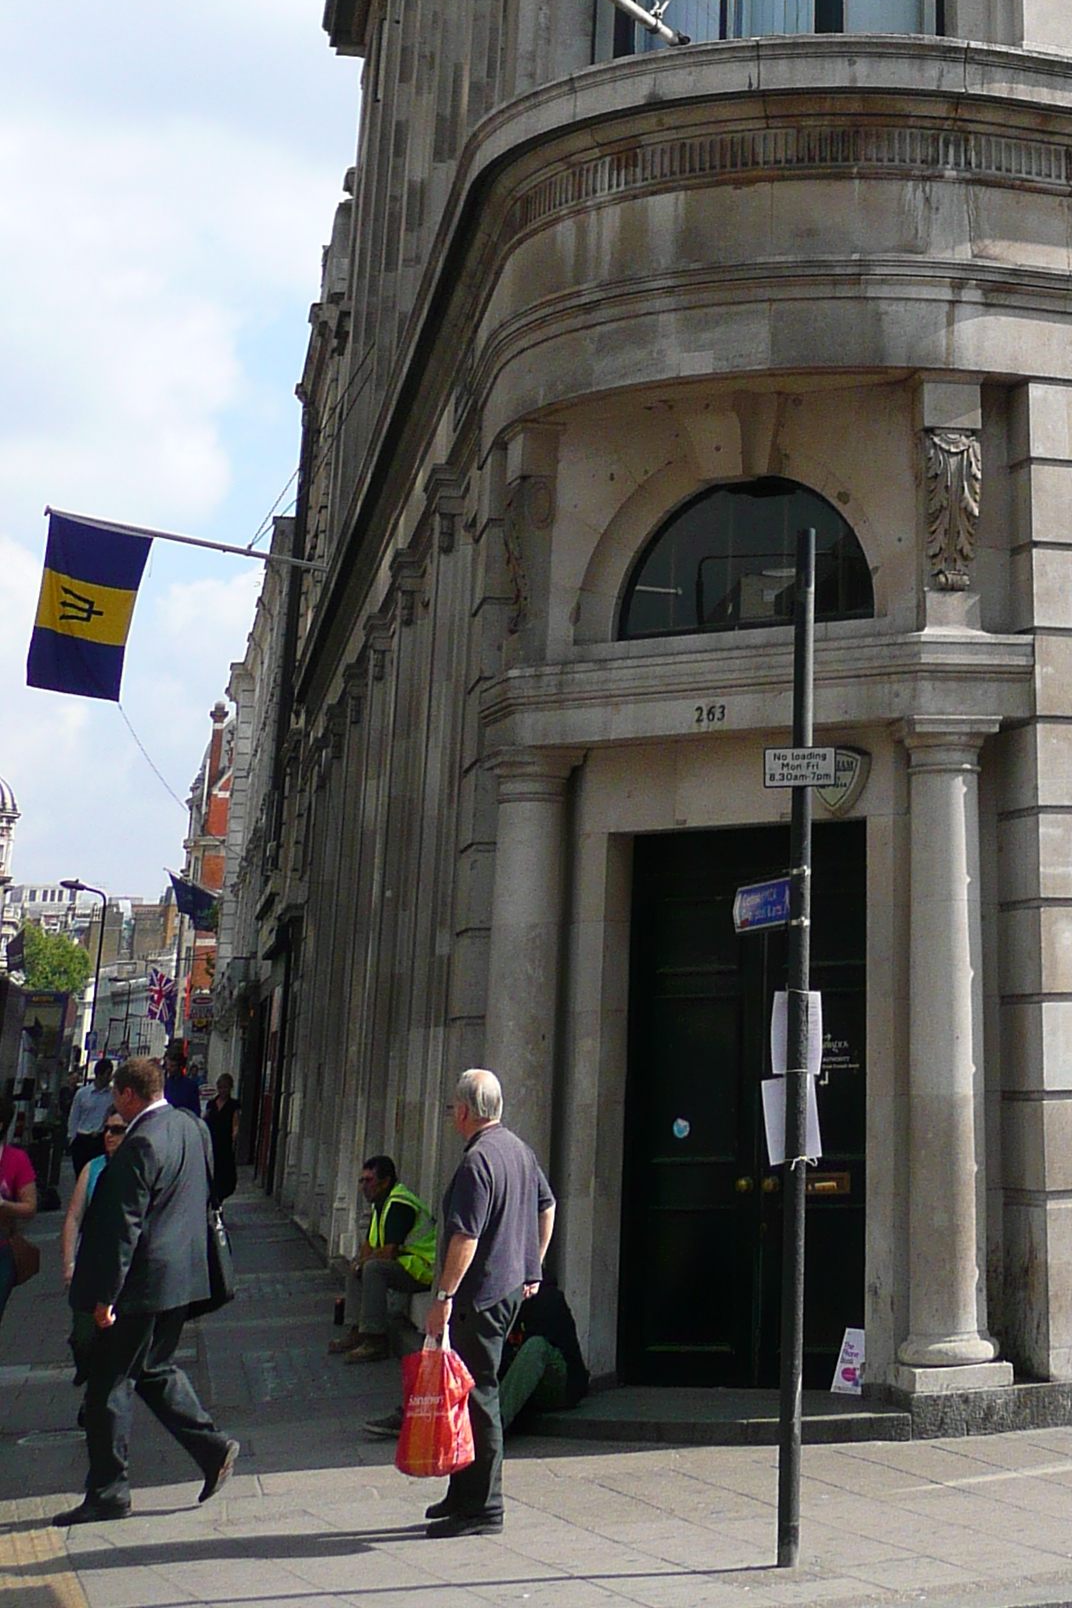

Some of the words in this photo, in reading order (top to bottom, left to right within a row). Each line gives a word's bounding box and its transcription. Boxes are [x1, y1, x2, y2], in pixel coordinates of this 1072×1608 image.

[695, 704, 726, 723] 263
[773, 752, 787, 762] No
[791, 751, 827, 762] loading
